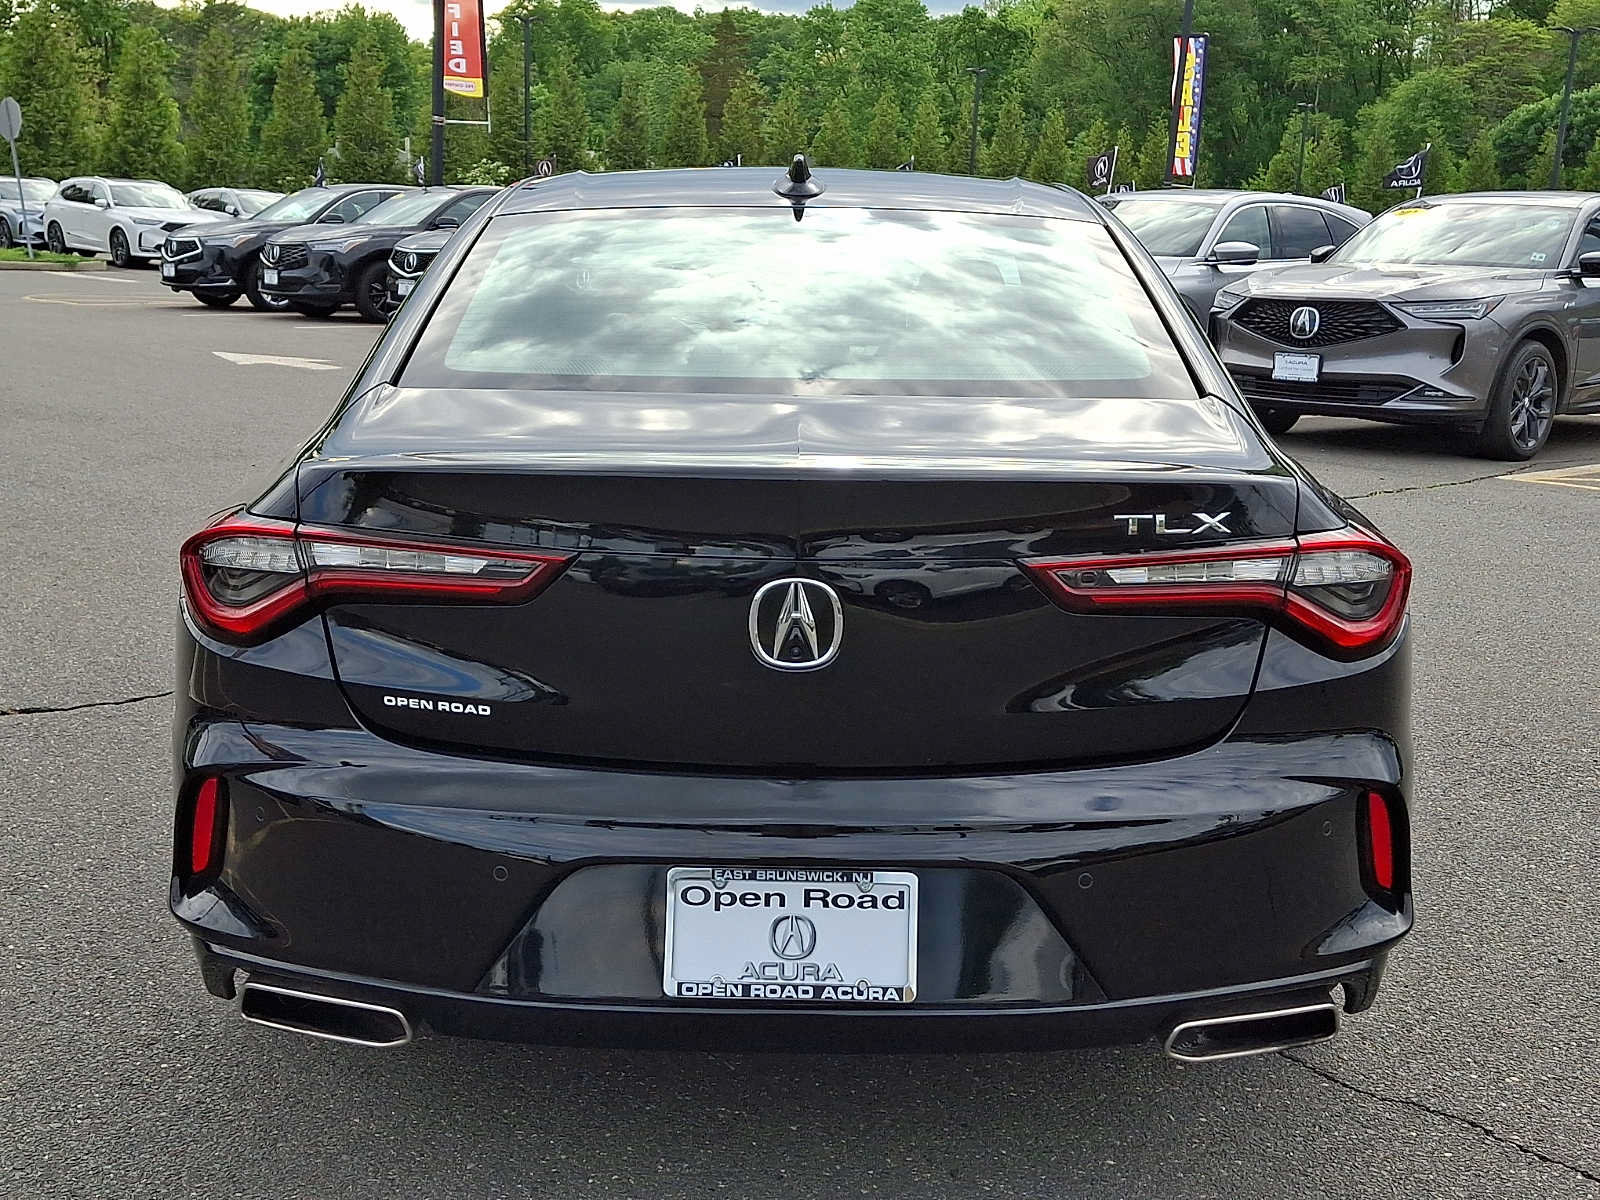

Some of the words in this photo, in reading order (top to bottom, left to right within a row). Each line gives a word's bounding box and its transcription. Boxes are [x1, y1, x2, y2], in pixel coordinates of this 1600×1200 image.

[1113, 511, 1231, 536] TLX
[383, 695, 434, 711] OPEN
[437, 701, 491, 716] ROAD
[713, 870, 752, 881] EAST
[756, 871, 848, 883] BRUNSWICK,
[852, 872, 873, 884] NJ
[680, 885, 786, 912] Open
[803, 888, 905, 910] Road
[738, 962, 844, 982] ACURA
[681, 983, 743, 998] OPEN
[751, 984, 814, 999] ROAD
[821, 985, 900, 1001] ACURA
